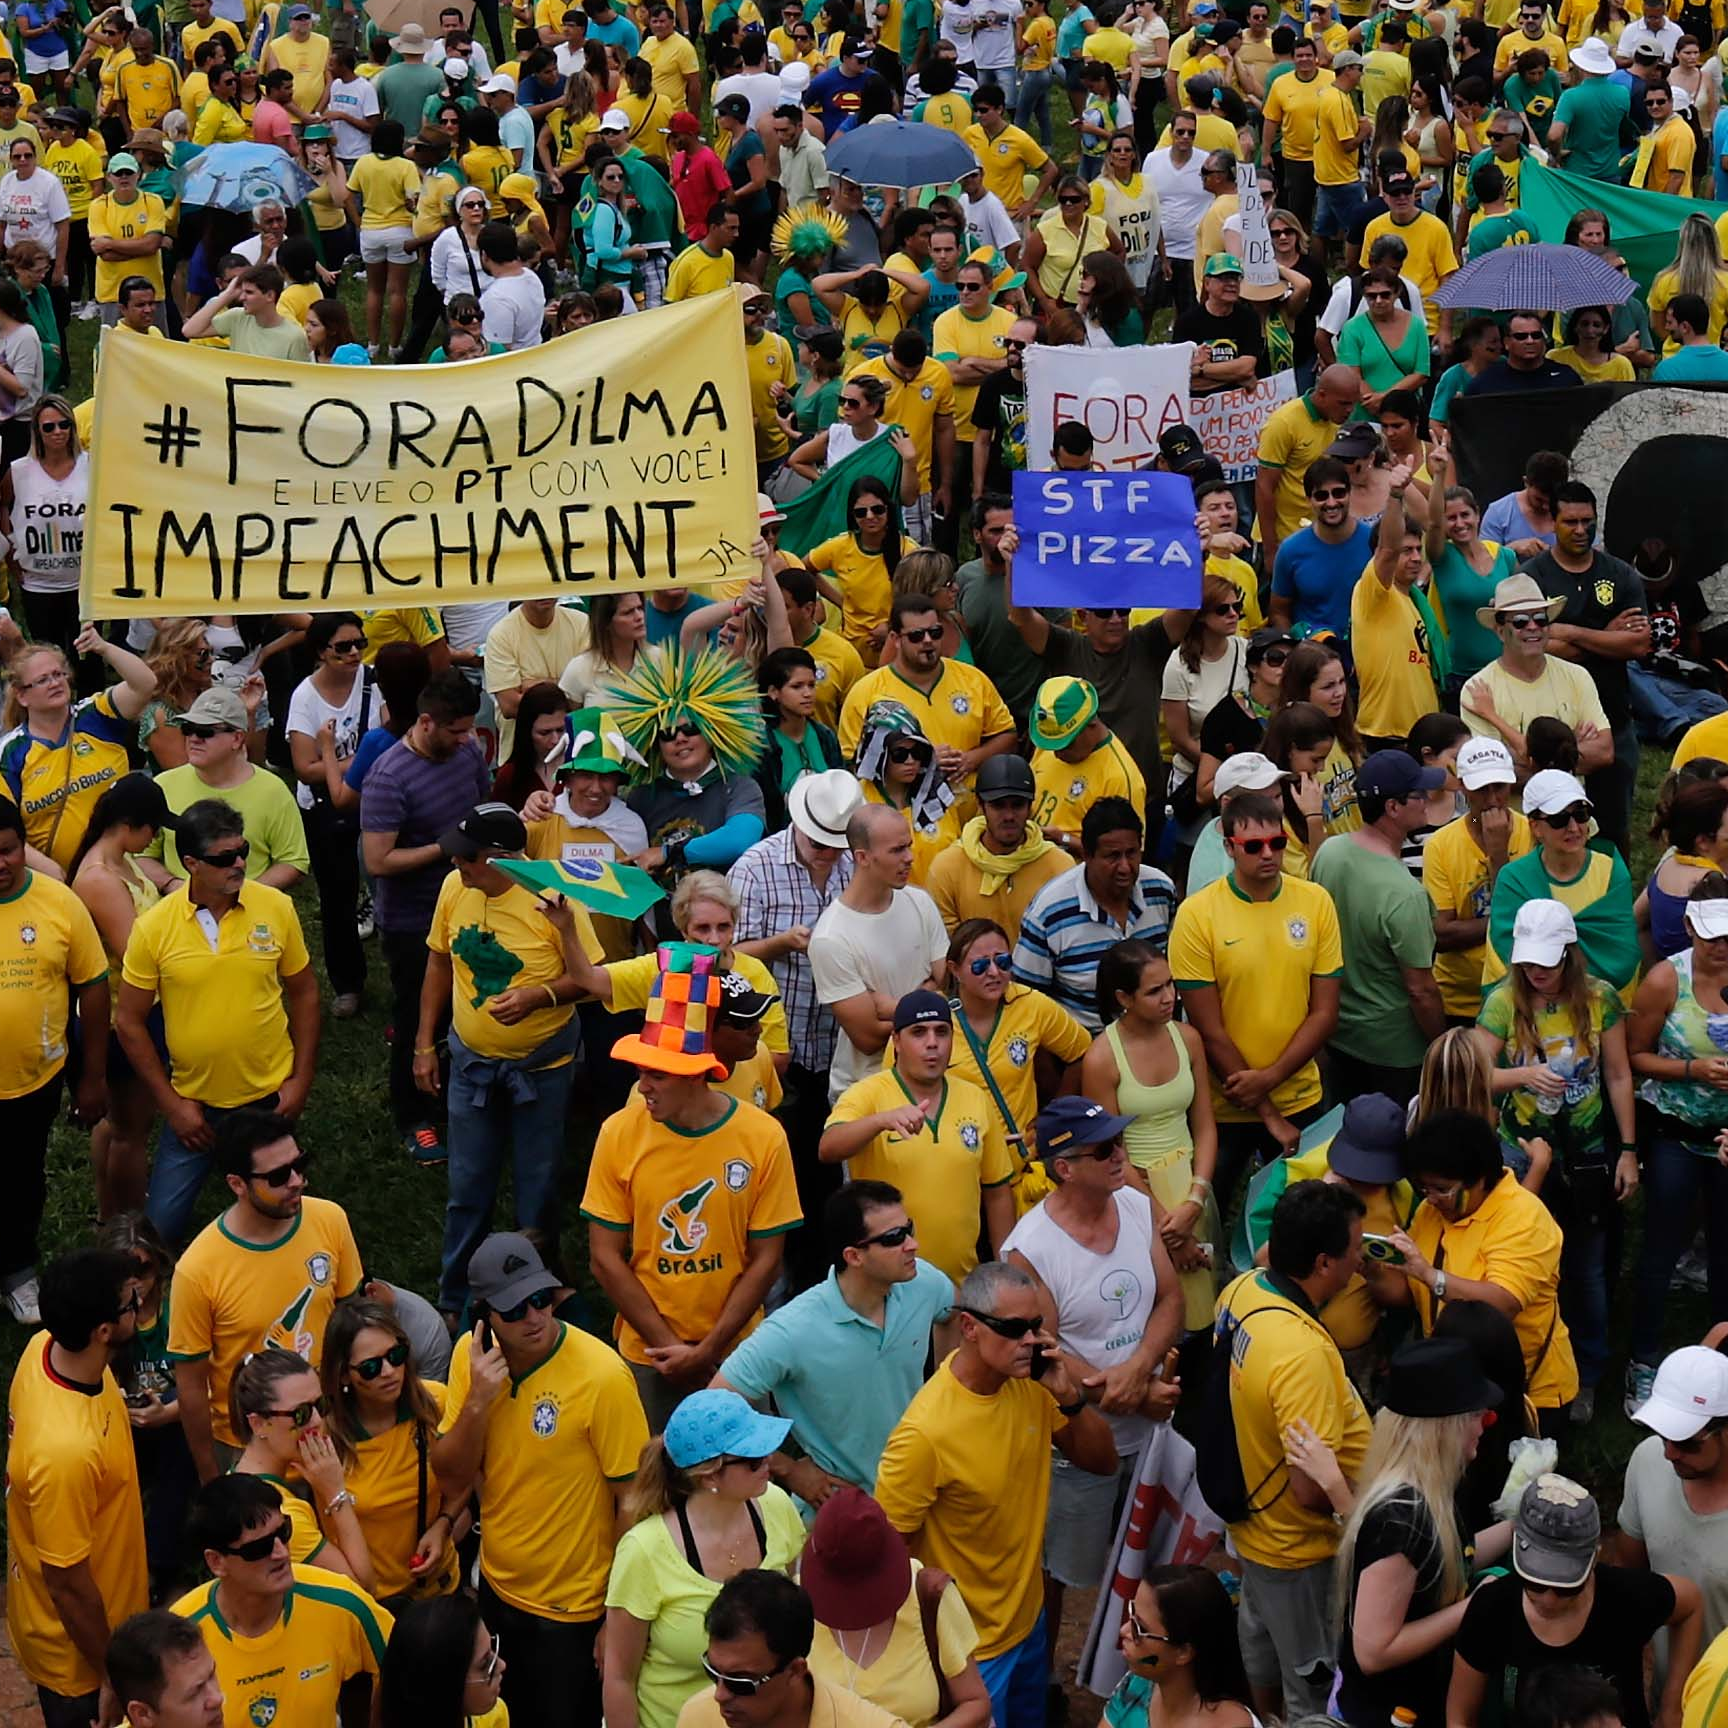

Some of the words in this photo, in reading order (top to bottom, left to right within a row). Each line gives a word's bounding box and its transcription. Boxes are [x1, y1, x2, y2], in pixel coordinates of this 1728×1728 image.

[144, 108, 157, 120] 12
[122, 223, 134, 238] 10
[1053, 392, 1187, 445] FORA
[1200, 416, 1222, 438] UM
[274, 478, 291, 507] E
[313, 479, 393, 506] LEVE
[408, 479, 434, 504] O
[454, 464, 512, 504] PT
[529, 459, 611, 499] COM
[635, 440, 729, 483] VOCÊ!
[1041, 477, 1152, 515] STF
[25, 503, 87, 519] FORA
[109, 500, 696, 601] IMPEACHMENT
[697, 531, 747, 578] JÁ
[1037, 531, 1193, 568] PIZZA
[25, 787, 64, 814] BANCO
[80, 767, 117, 790] BRASIL
[1033, 790, 1058, 827] 13
[570, 848, 605, 858] DILMA
[9, 967, 33, 978] Deus
[0, 979, 33, 992] Senhor
[656, 1252, 724, 1276] Brasil
